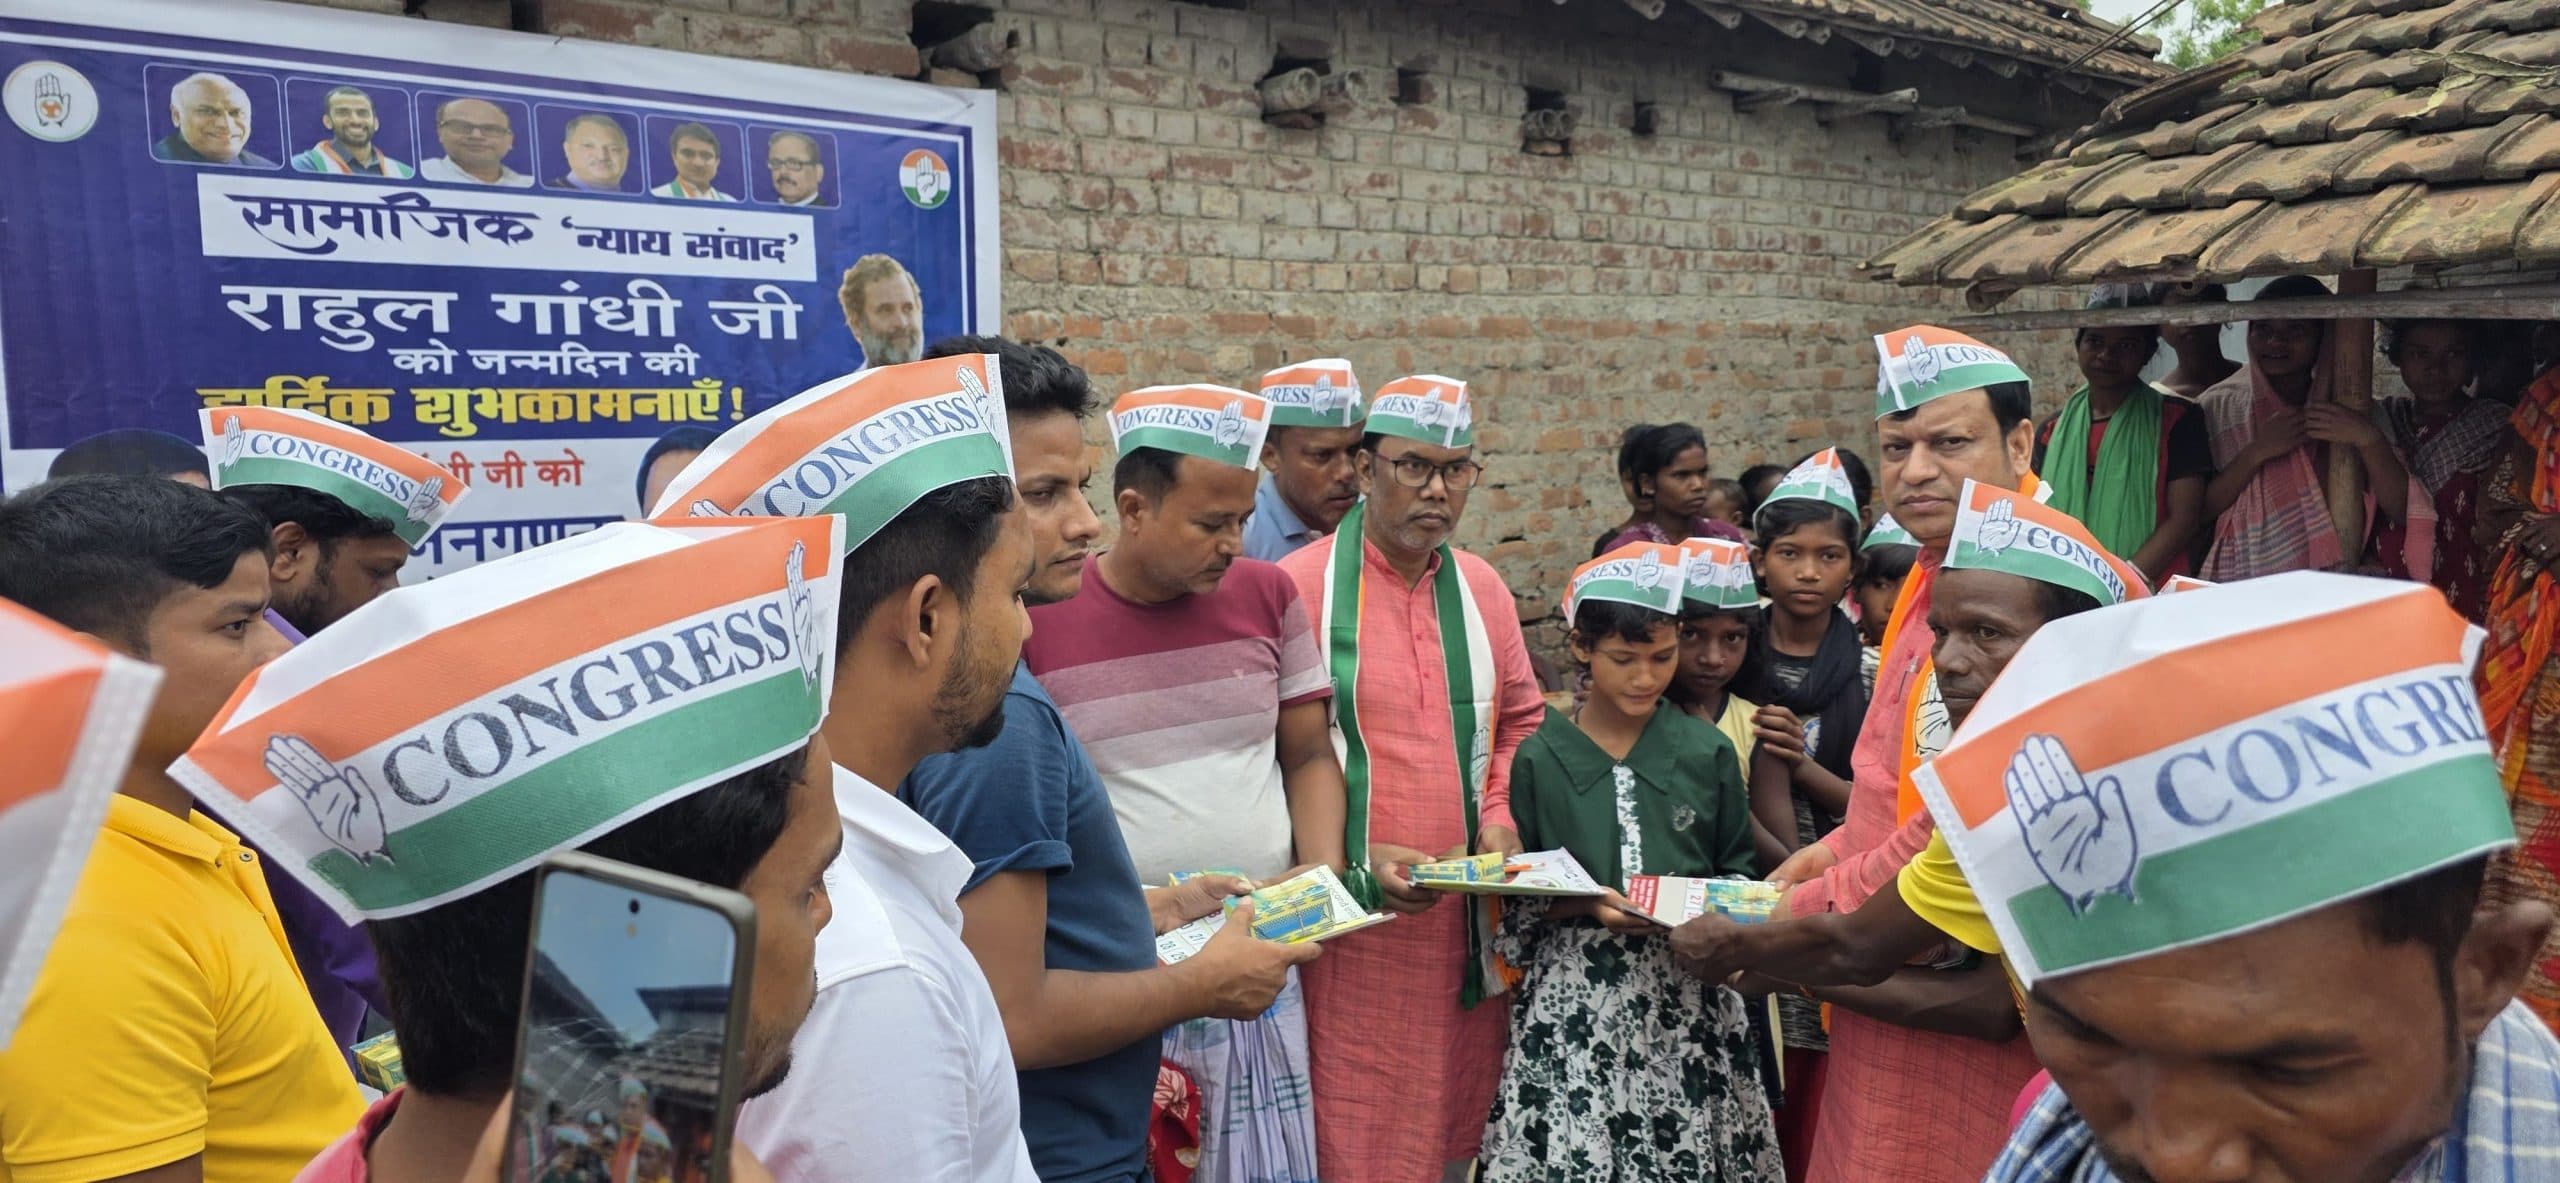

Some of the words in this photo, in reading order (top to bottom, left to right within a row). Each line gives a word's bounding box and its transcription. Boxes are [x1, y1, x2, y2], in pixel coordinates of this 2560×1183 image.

[224, 191, 542, 255] सामाजिक
[221, 285, 458, 352] राहुल
[491, 279, 682, 337] गांधी
[708, 284, 803, 340] जी
[388, 339, 458, 375] को
[467, 342, 631, 378] जन्मदिन
[640, 344, 700, 376] की
[251, 433, 415, 502] CONGRESS
[482, 450, 527, 488] जी
[533, 448, 585, 487] को
[764, 396, 980, 517] CONGRESS
[383, 601, 790, 807] CONGRESS
